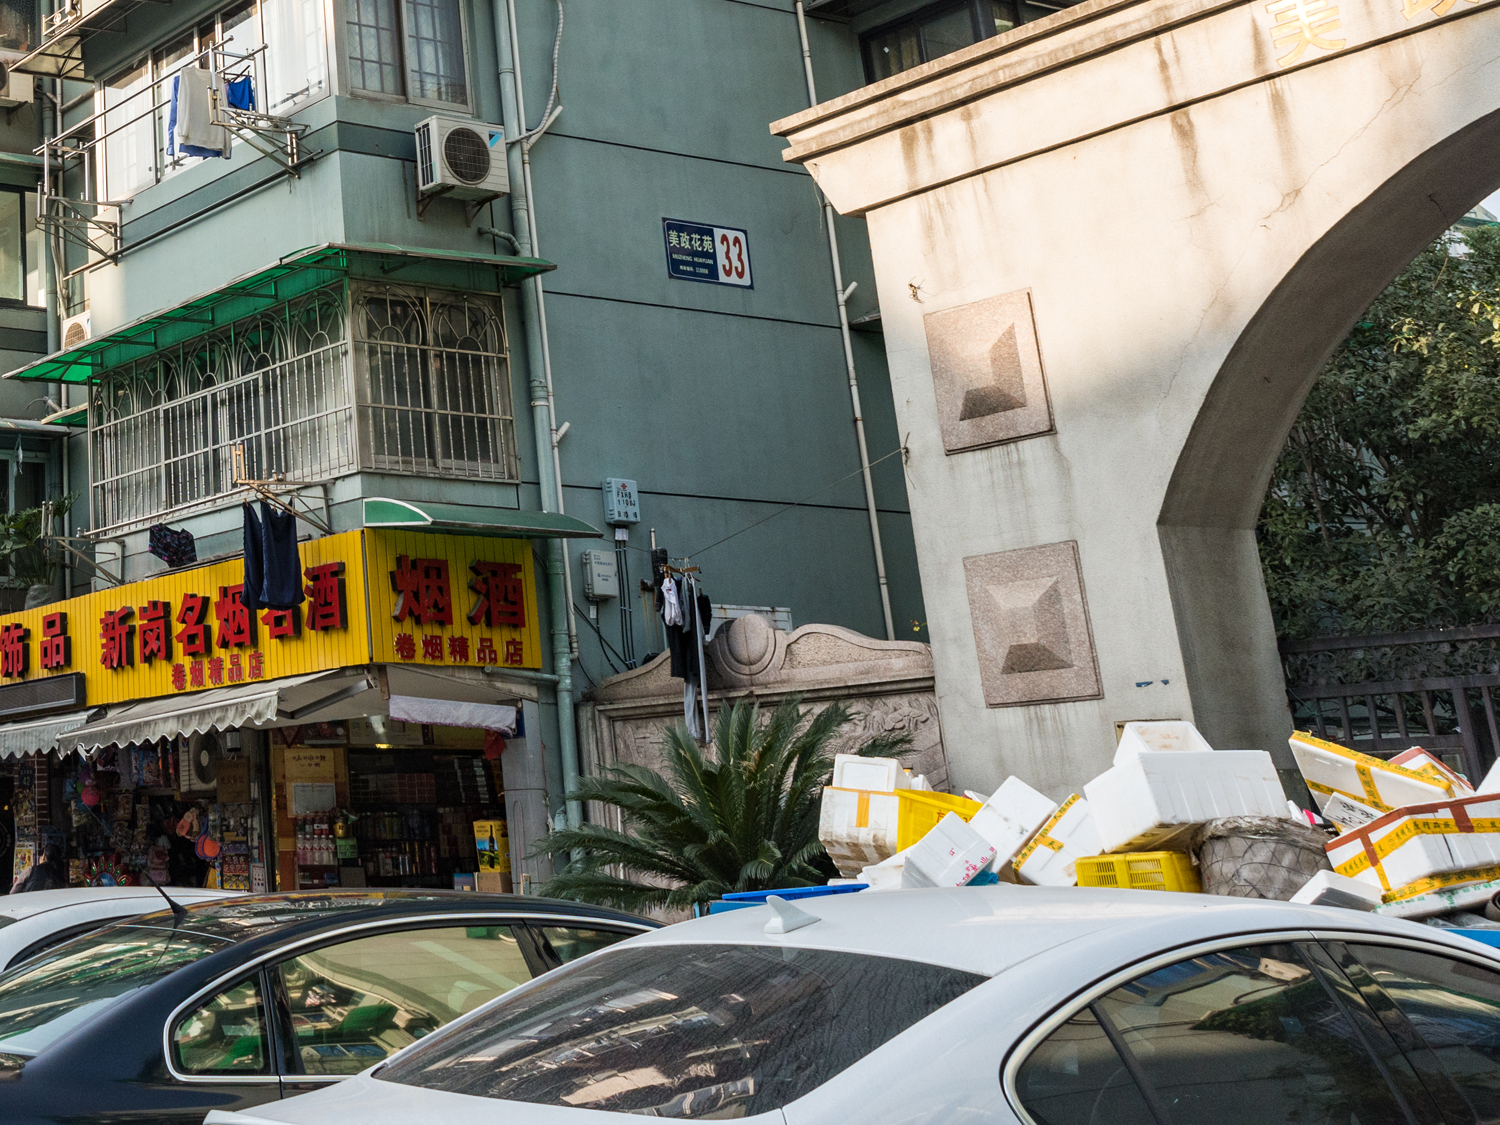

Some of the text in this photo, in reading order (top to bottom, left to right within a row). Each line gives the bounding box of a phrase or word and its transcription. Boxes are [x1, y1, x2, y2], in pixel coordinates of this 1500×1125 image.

[668, 229, 714, 253] 美政花苑
[720, 233, 746, 280] 33
[389, 554, 526, 628] 烟酒
[393, 632, 524, 665] 卷烟精品店
[171, 650, 264, 690] 卷烟精品店
